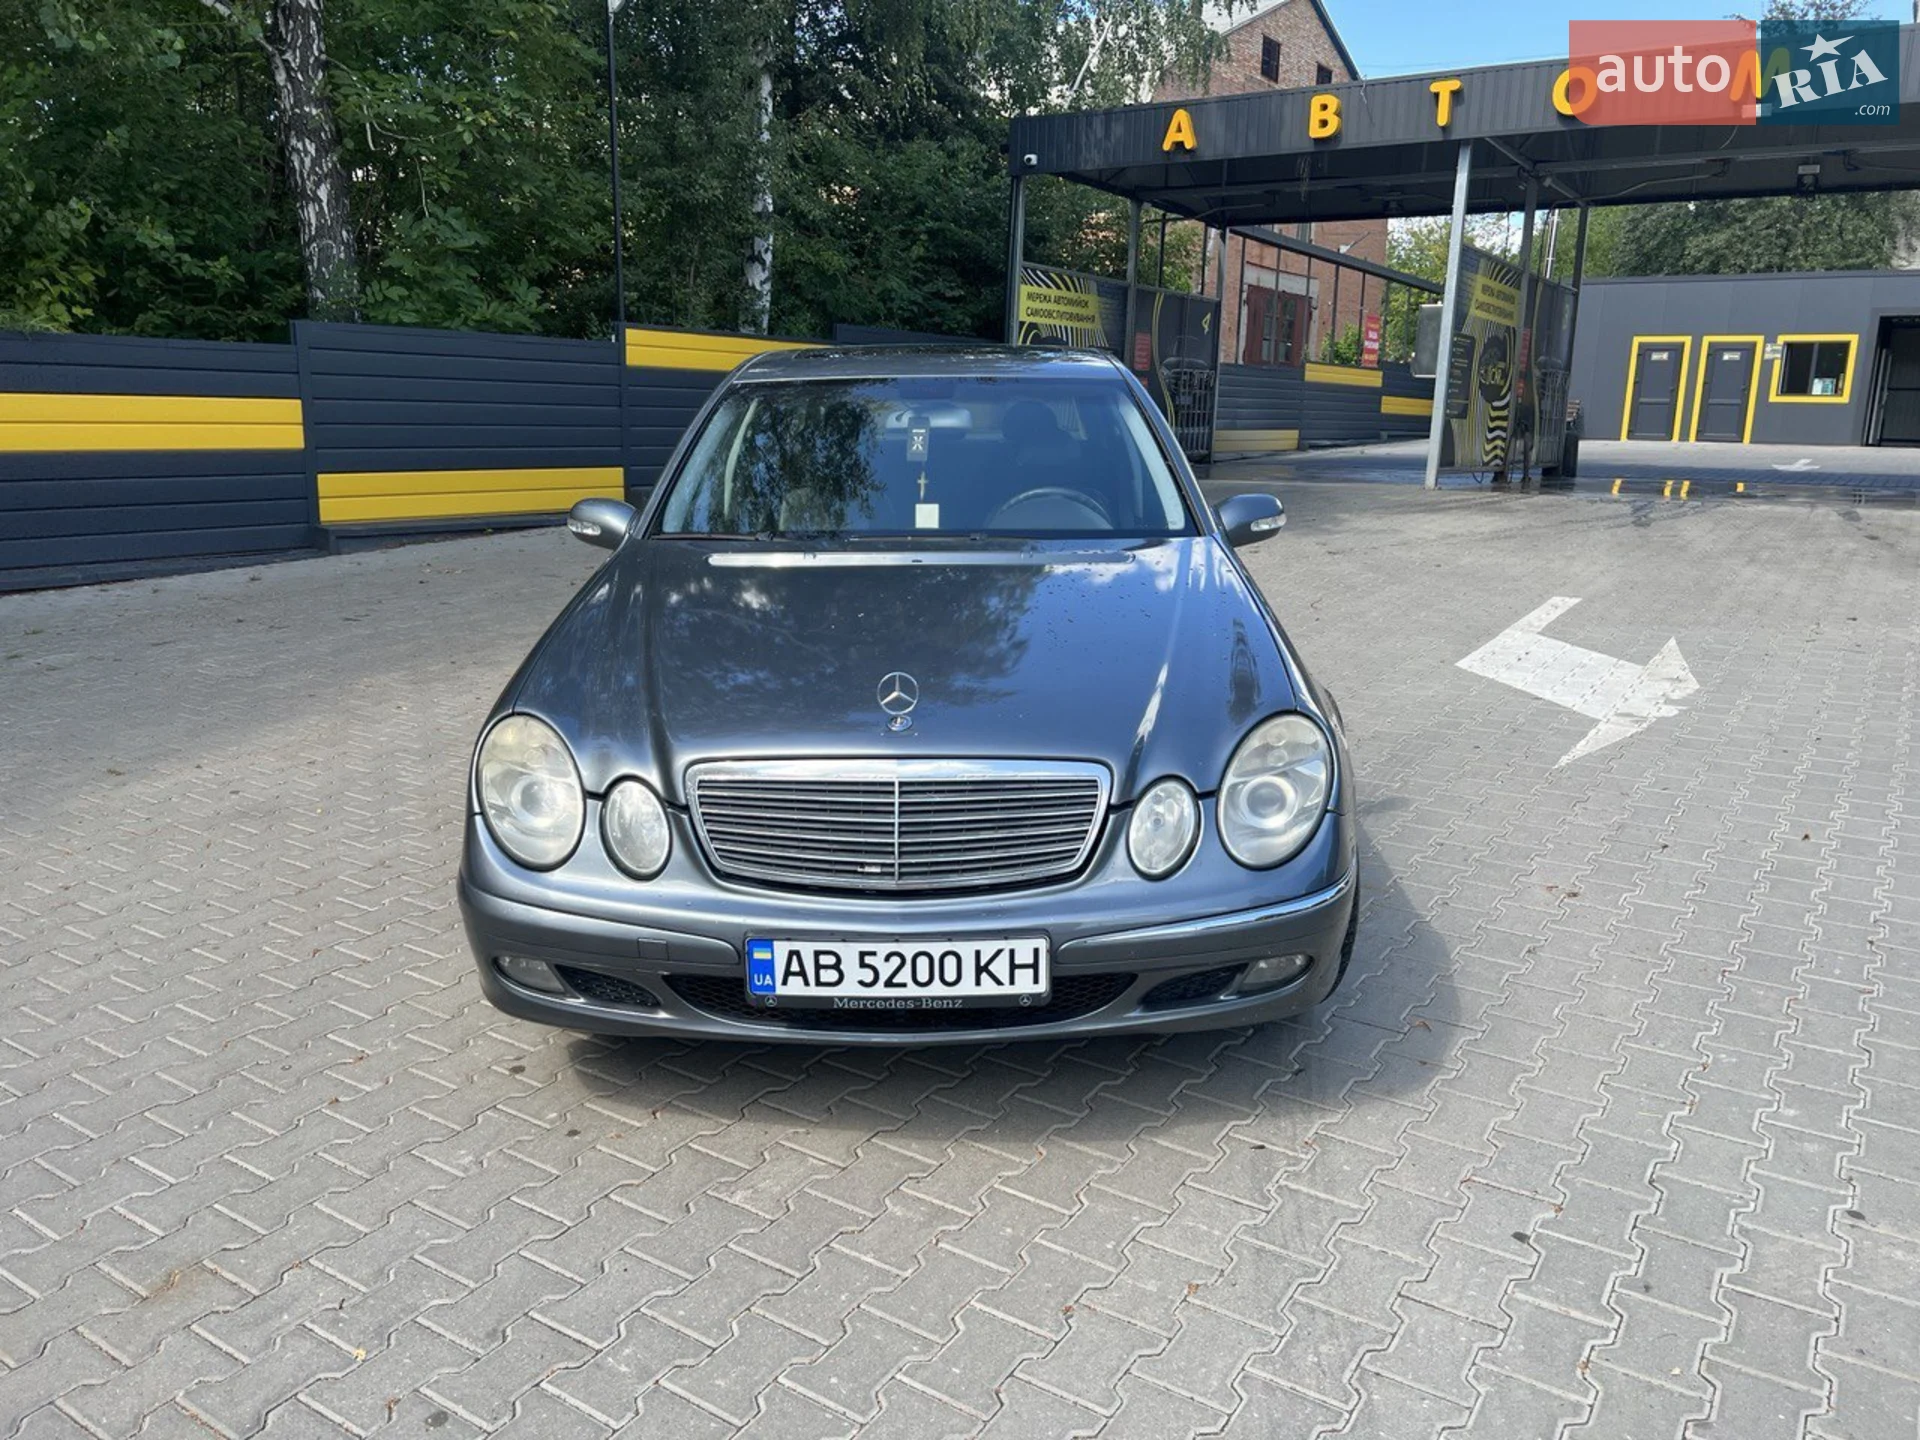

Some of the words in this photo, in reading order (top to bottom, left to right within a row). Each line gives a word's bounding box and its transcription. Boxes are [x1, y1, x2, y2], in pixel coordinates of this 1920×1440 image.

[1201, 312, 1212, 335] 4
[781, 949, 845, 988] AB
[857, 949, 962, 989] 5200
[975, 947, 1040, 987] KH
[754, 973, 773, 987] UA
[833, 996, 963, 1009] Mercedes-Benz
